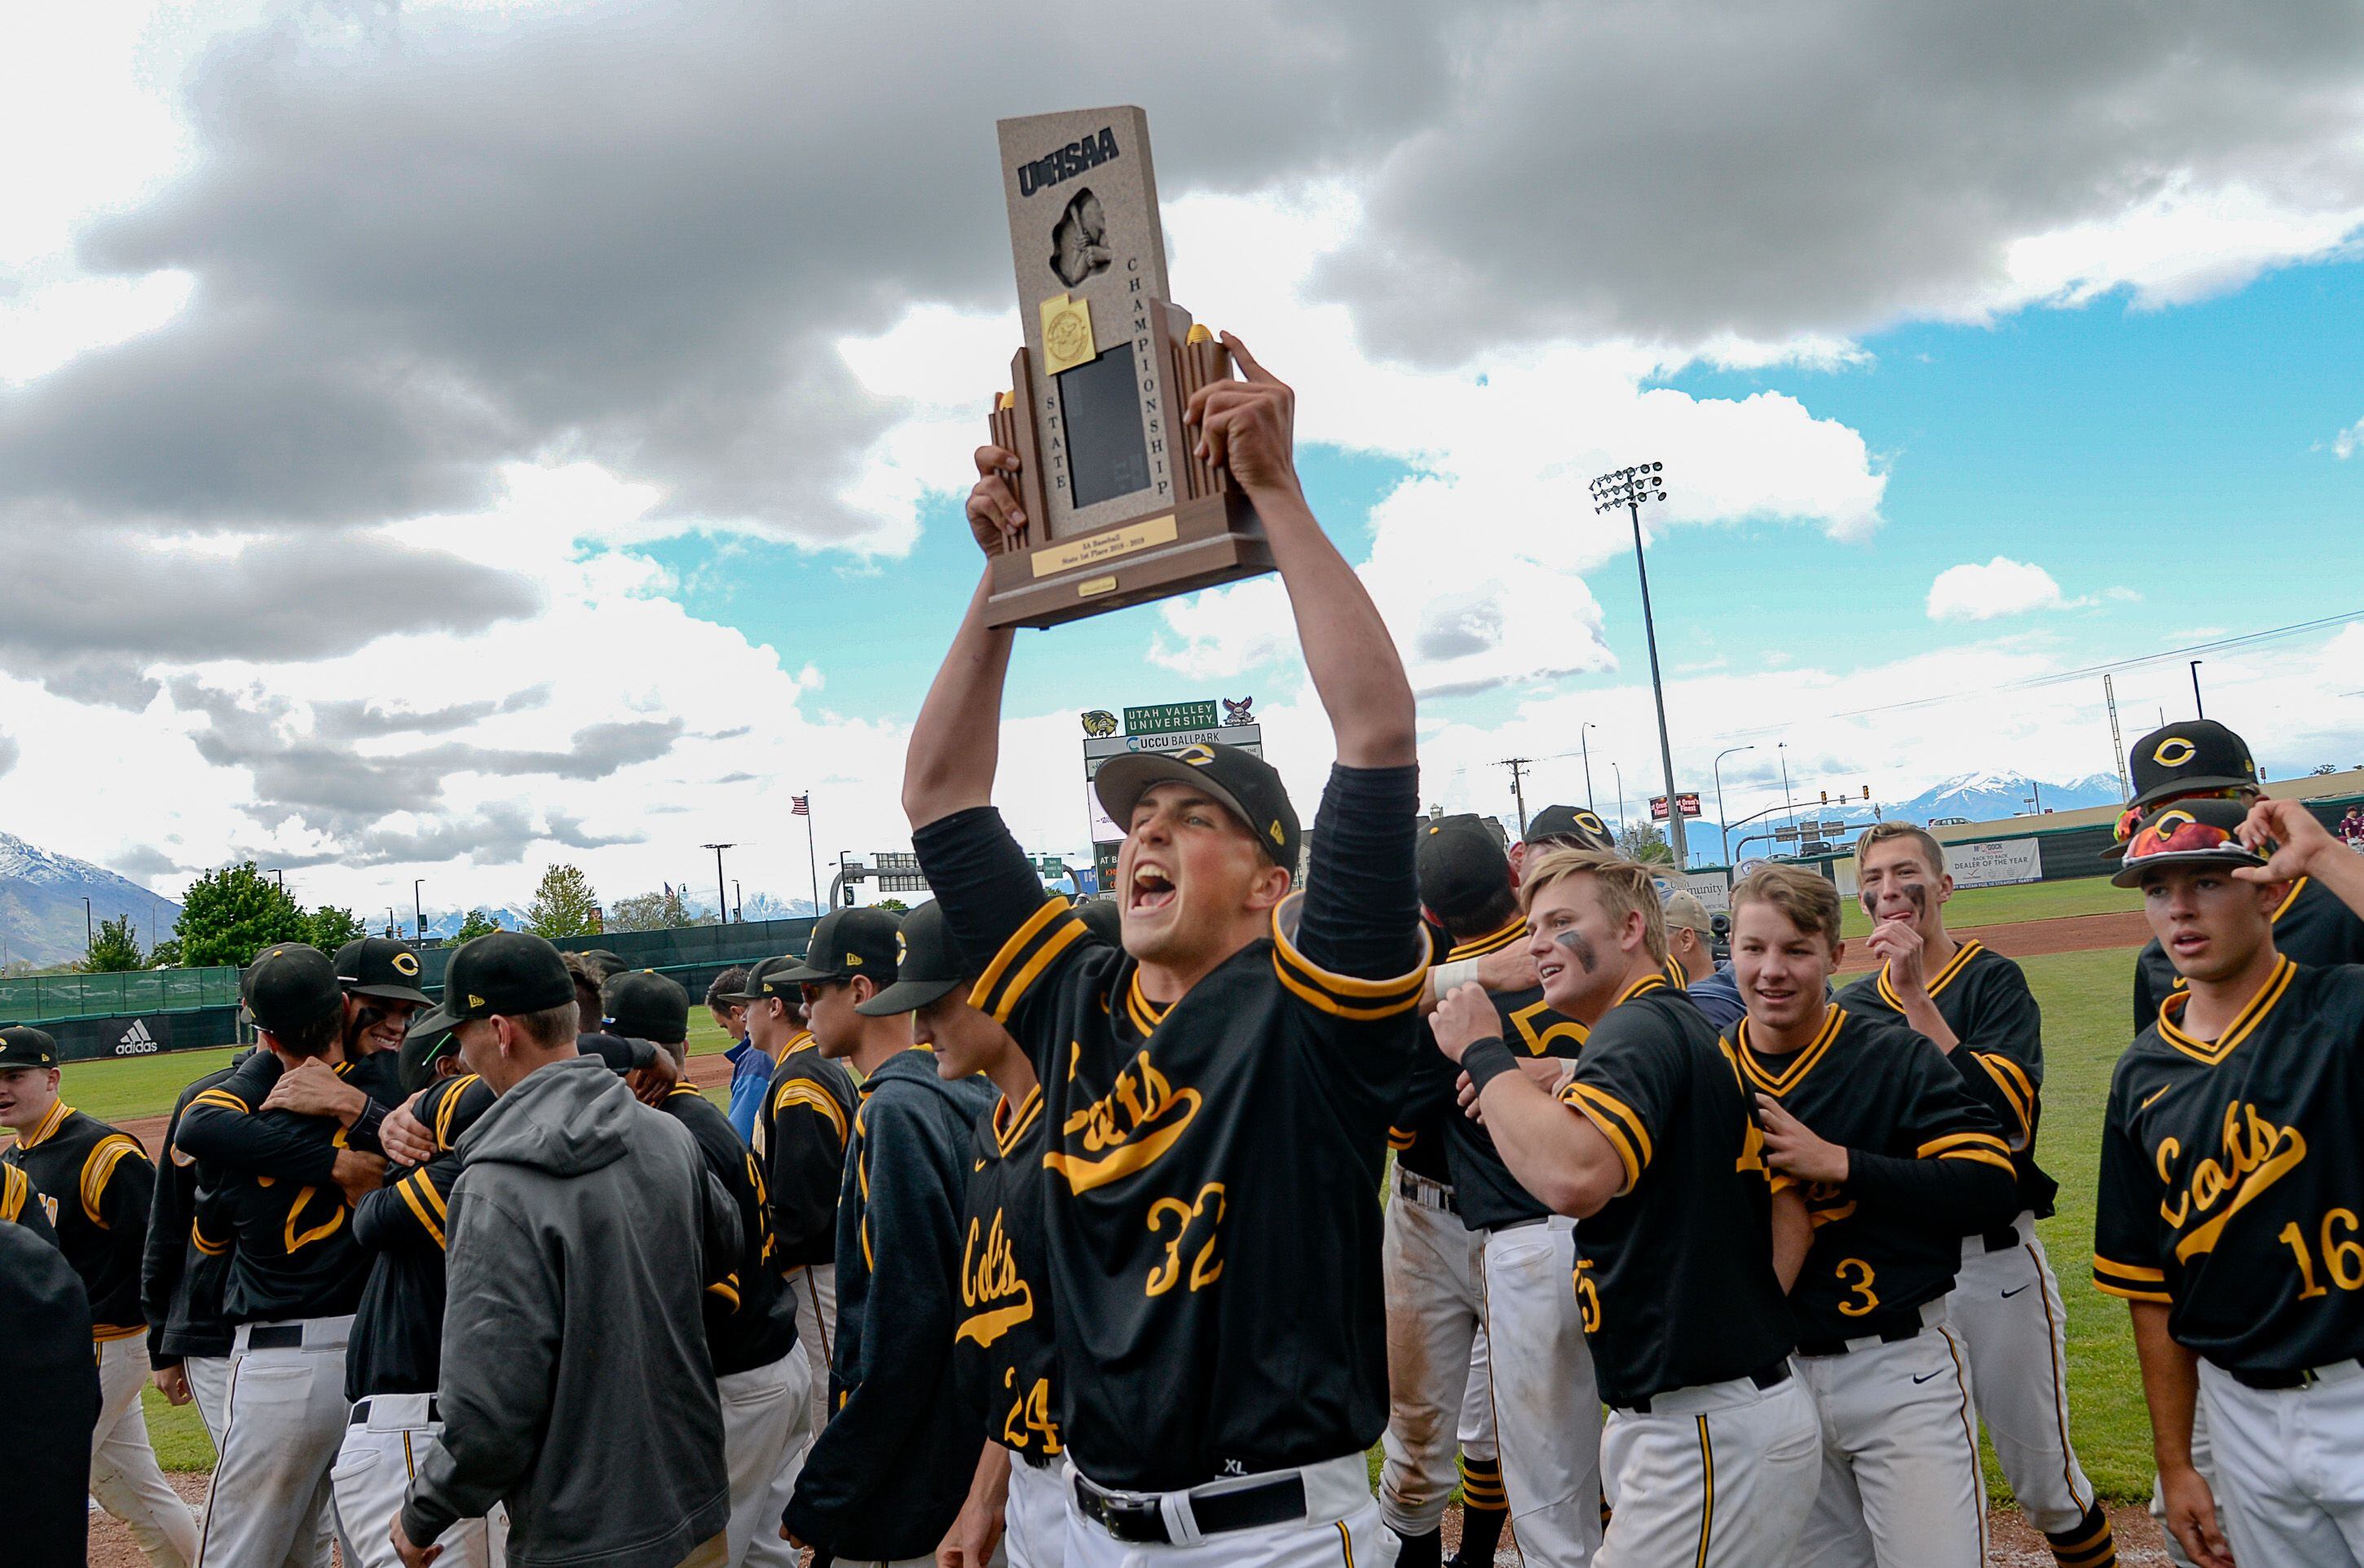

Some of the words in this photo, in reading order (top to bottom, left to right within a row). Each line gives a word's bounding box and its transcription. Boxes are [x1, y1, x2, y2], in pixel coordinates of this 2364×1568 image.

[1127, 258, 1167, 495] CHAMPIONSHIP
[1047, 397, 1066, 489] STATE
[1128, 709, 1159, 720] UTAH
[1166, 704, 1212, 717] VALLEY
[1130, 714, 1214, 731] UNIVERSITY
[1140, 736, 1169, 749] UCCU
[1171, 733, 1220, 746] BALLPARK
[1100, 857, 1109, 865] AT
[1955, 861, 1981, 870] DEALER
[116, 1040, 158, 1055] adidas
[2157, 1100, 2306, 1229] Colts
[960, 1207, 1033, 1310] Colts
[1145, 1182, 1226, 1297] 32
[2278, 1207, 2364, 1302] 16
[1835, 1257, 1880, 1318] 3
[1004, 1366, 1065, 1455] 24
[1224, 1459, 1248, 1475] XL
